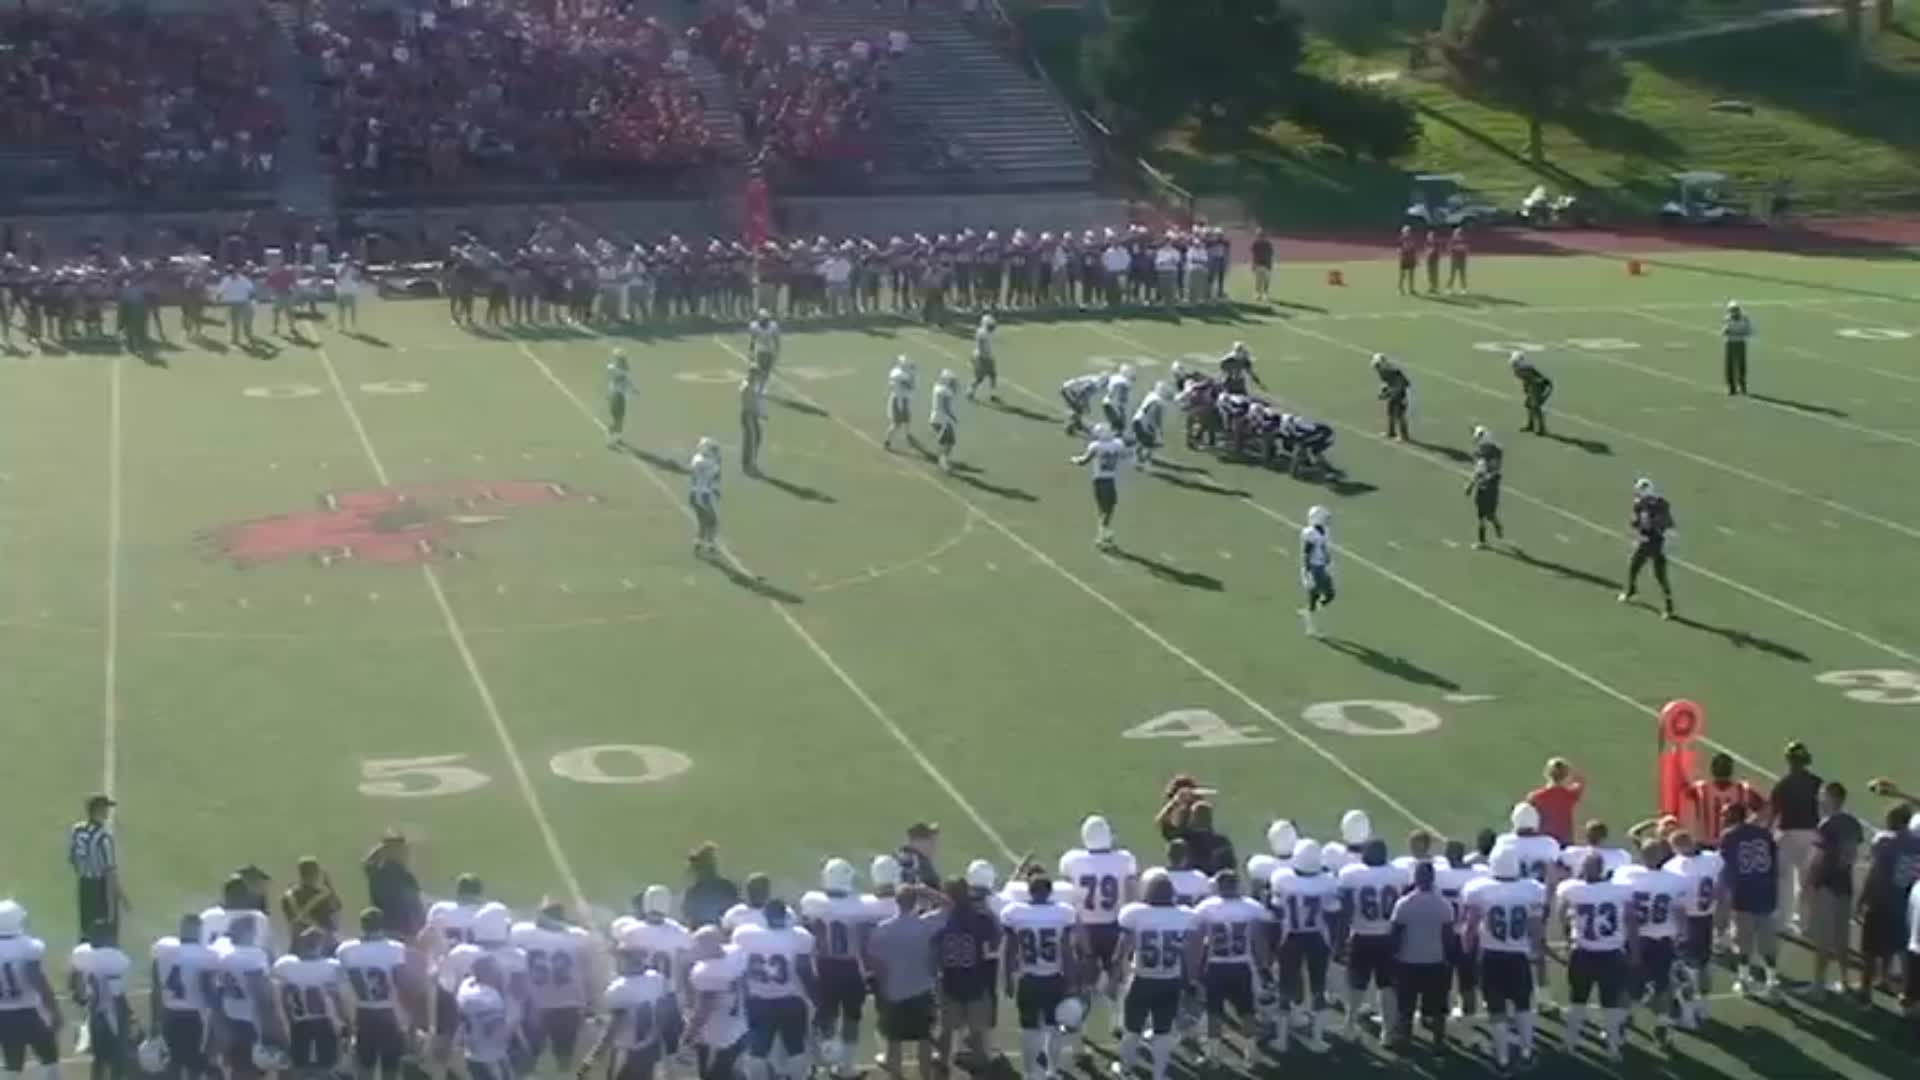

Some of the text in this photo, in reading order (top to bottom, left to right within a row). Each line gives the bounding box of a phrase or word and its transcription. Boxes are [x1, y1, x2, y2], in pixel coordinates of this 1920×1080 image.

[1079, 875, 1119, 911] 79
[1577, 902, 1618, 940] 73
[1140, 930, 1181, 969] 55
